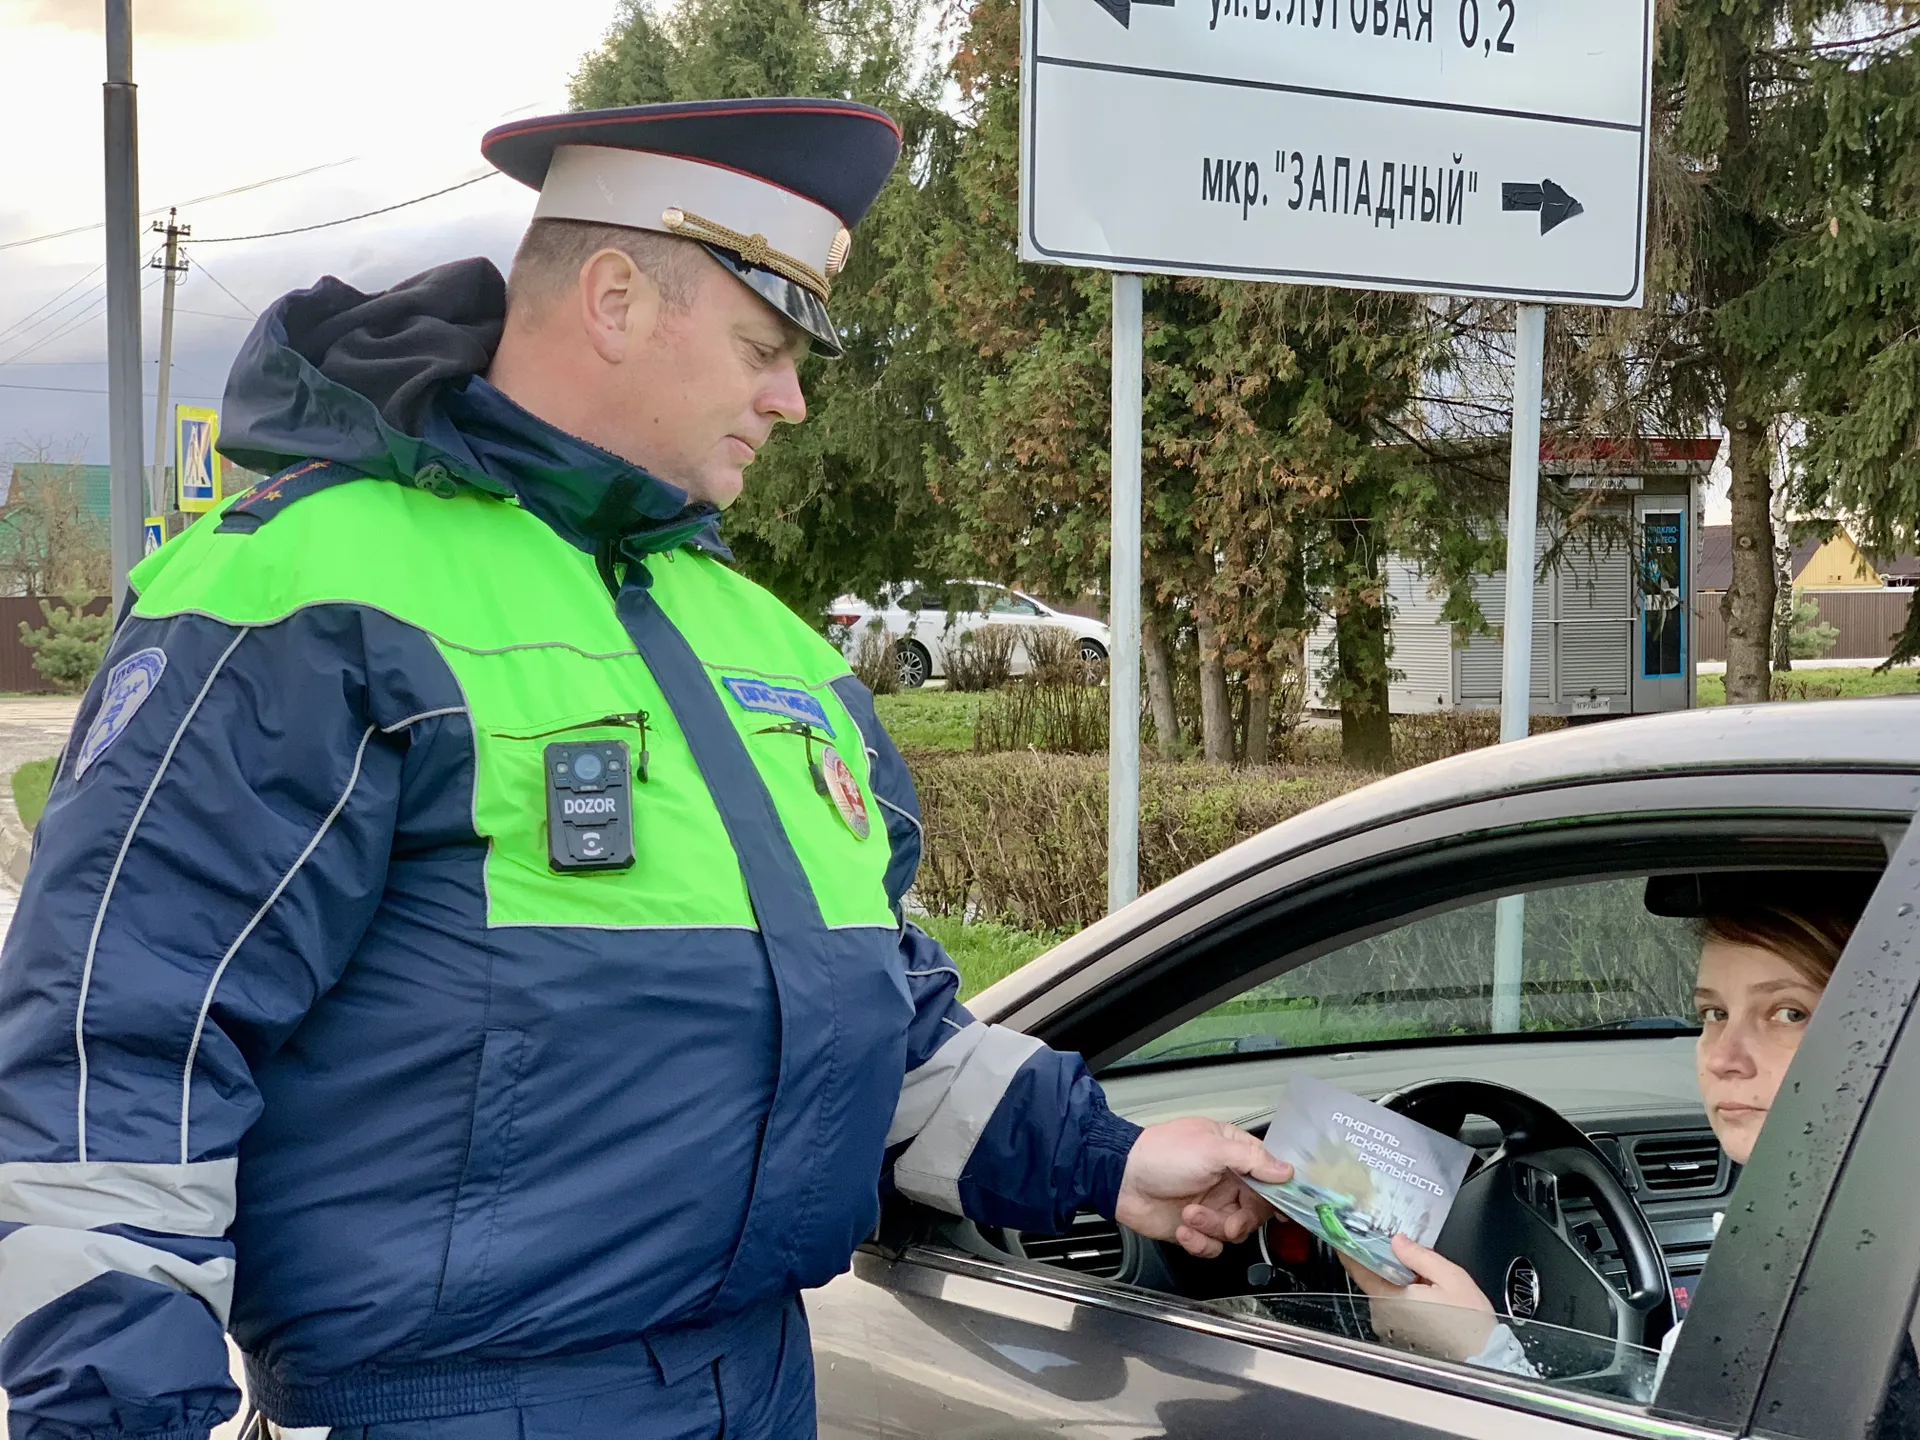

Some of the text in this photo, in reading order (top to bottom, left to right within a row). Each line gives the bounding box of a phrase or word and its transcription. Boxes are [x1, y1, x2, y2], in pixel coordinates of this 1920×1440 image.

[1459, 0, 1516, 58] 0,2
[1201, 149, 1479, 230] мкр. "ЗАПАДНЫЙ"
[564, 797, 617, 815] DOZOR
[1331, 1111, 1401, 1148] АЛКОГОЛЬ
[1344, 1131, 1417, 1169] ИСКАЖАЕТ
[1358, 1151, 1445, 1197] РЕАЛЬНОСТЬ
[1512, 1267, 1535, 1316] KIA
